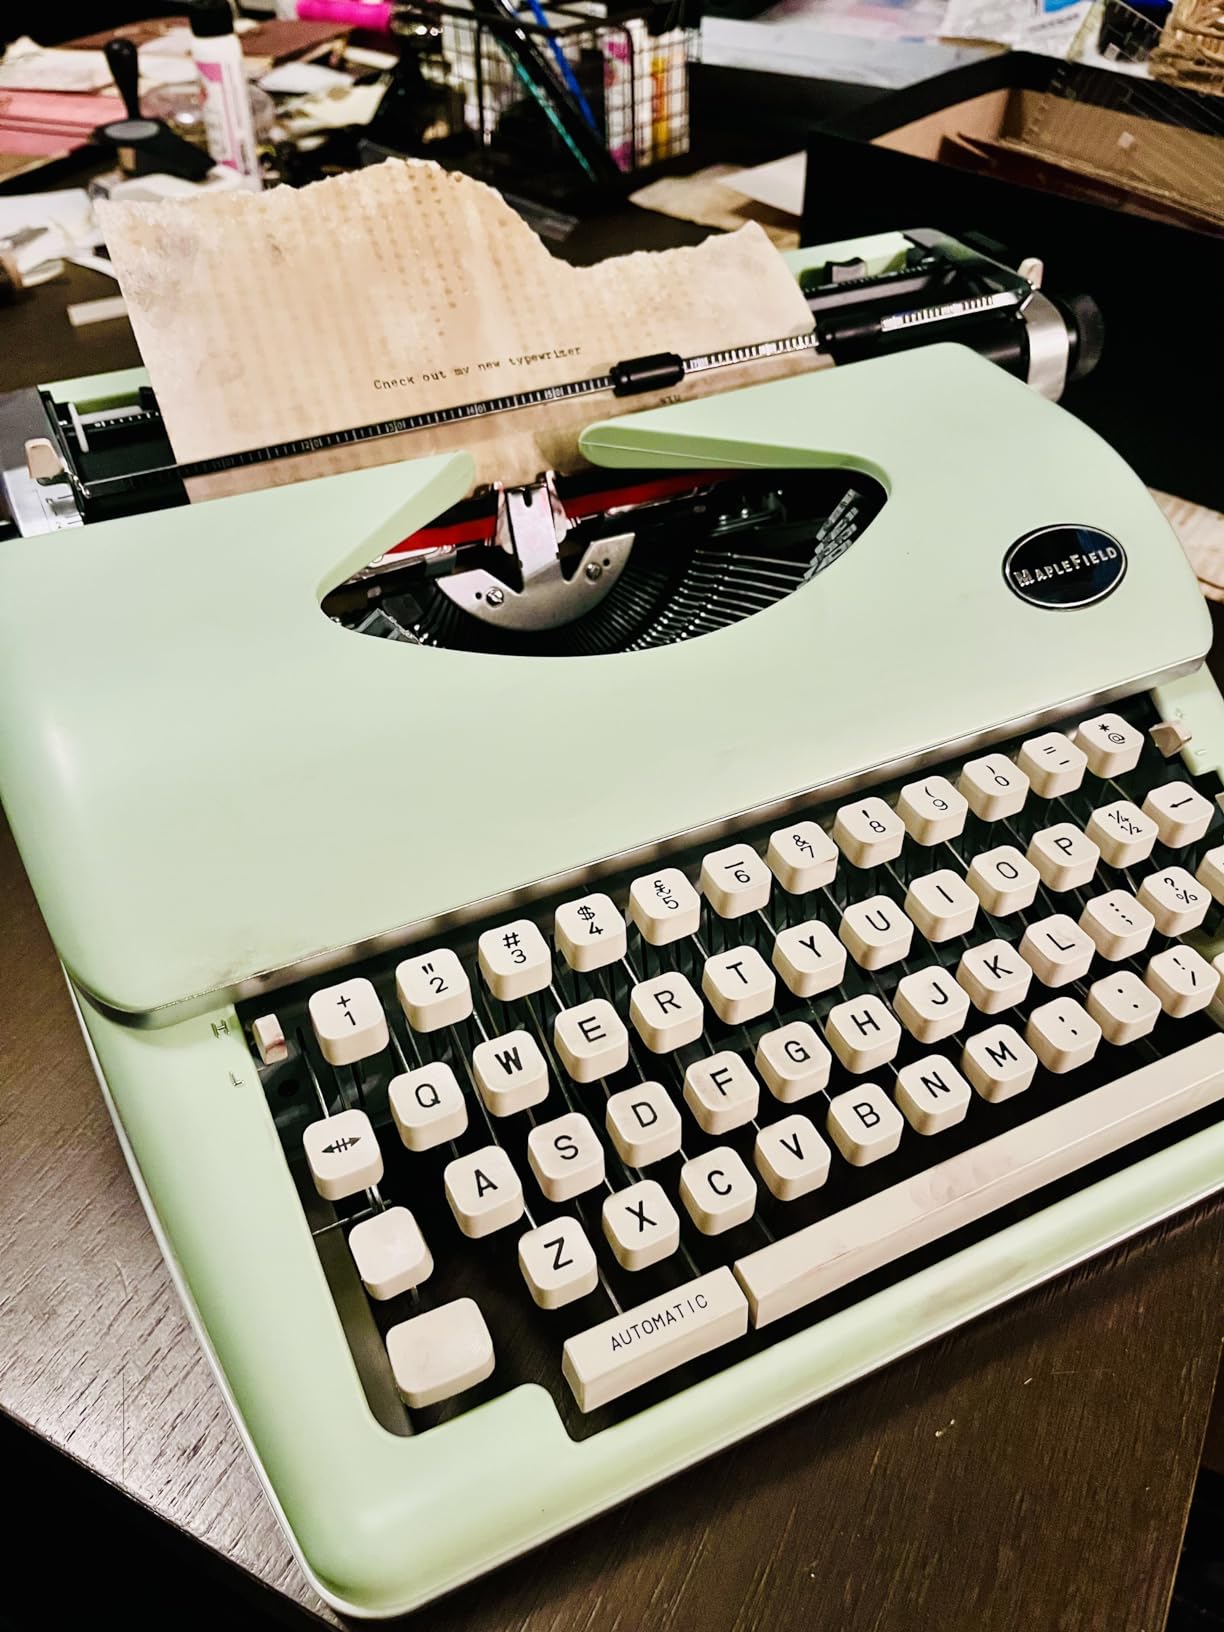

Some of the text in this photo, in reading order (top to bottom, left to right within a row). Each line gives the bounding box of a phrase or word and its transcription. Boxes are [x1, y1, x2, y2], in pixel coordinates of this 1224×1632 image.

[422, 370, 447, 382] out
[477, 360, 501, 372] new
[1012, 546, 1118, 588] MAPLEFIELD
[994, 775, 1010, 787] 0
[932, 798, 949, 811] 9
[869, 820, 887, 833] 8
[799, 845, 815, 859] 7
[1053, 837, 1073, 856] P
[734, 869, 751, 884] 6
[995, 861, 1019, 880] O
[663, 895, 679, 910] 5
[935, 885, 954, 904] I
[576, 905, 596, 921] $
[864, 910, 891, 932] U
[588, 921, 604, 935] 4
[798, 935, 822, 958] Y
[1045, 933, 1076, 952] L
[510, 948, 527, 964] 3
[982, 954, 1014, 979] K
[429, 976, 449, 994] 2
[725, 961, 749, 985] T
[653, 990, 682, 1015] R
[931, 981, 949, 1005] J
[211, 1019, 230, 1038] H
[343, 1010, 357, 1026] 1
[577, 1015, 607, 1043] E
[850, 1009, 881, 1036] H
[494, 1046, 523, 1076] W
[784, 1040, 811, 1063] G
[984, 1040, 1018, 1068] M
[709, 1067, 733, 1097] F
[919, 1071, 951, 1099] N
[414, 1083, 441, 1109] Q
[630, 1101, 658, 1129] D
[852, 1102, 881, 1129] B
[553, 1134, 579, 1161] S
[779, 1132, 804, 1161] V
[474, 1168, 499, 1198] A
[707, 1169, 733, 1196] C
[624, 1199, 658, 1233] X
[543, 1236, 574, 1271] Z
[611, 1294, 708, 1352] AUTOMATIC
